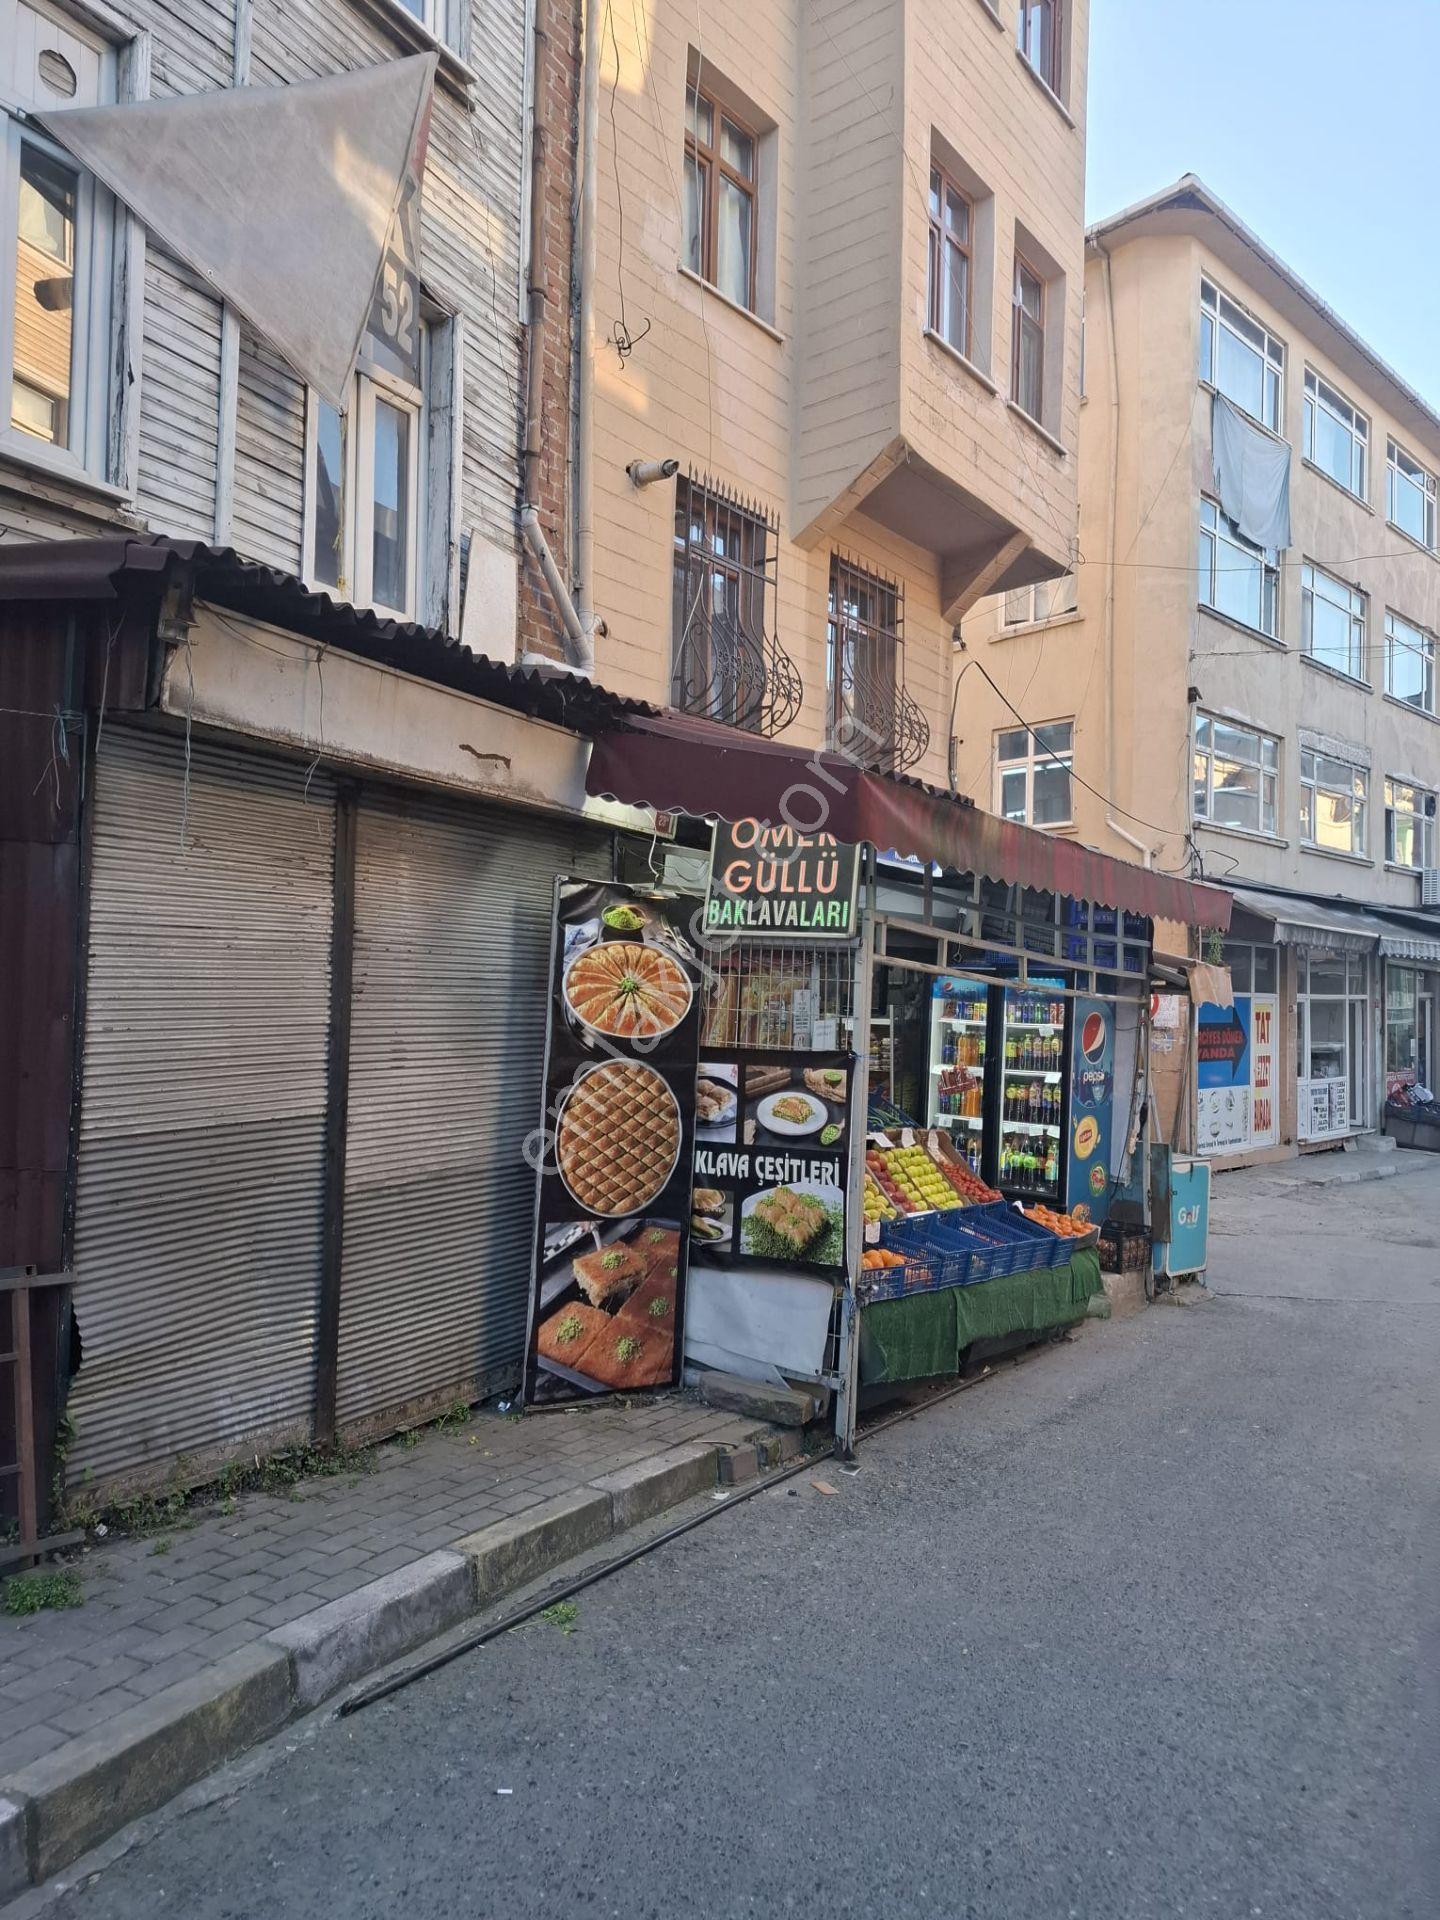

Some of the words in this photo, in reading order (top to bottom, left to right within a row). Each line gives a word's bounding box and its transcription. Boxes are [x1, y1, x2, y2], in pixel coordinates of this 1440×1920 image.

[724, 851, 838, 893] GÜLLÜ
[708, 900, 849, 927] BAKLAVALARI
[1255, 1011, 1271, 1044] TAT
[694, 1150, 750, 1180] KLAVA
[755, 1152, 840, 1188] ÇEŞİTLERİ
